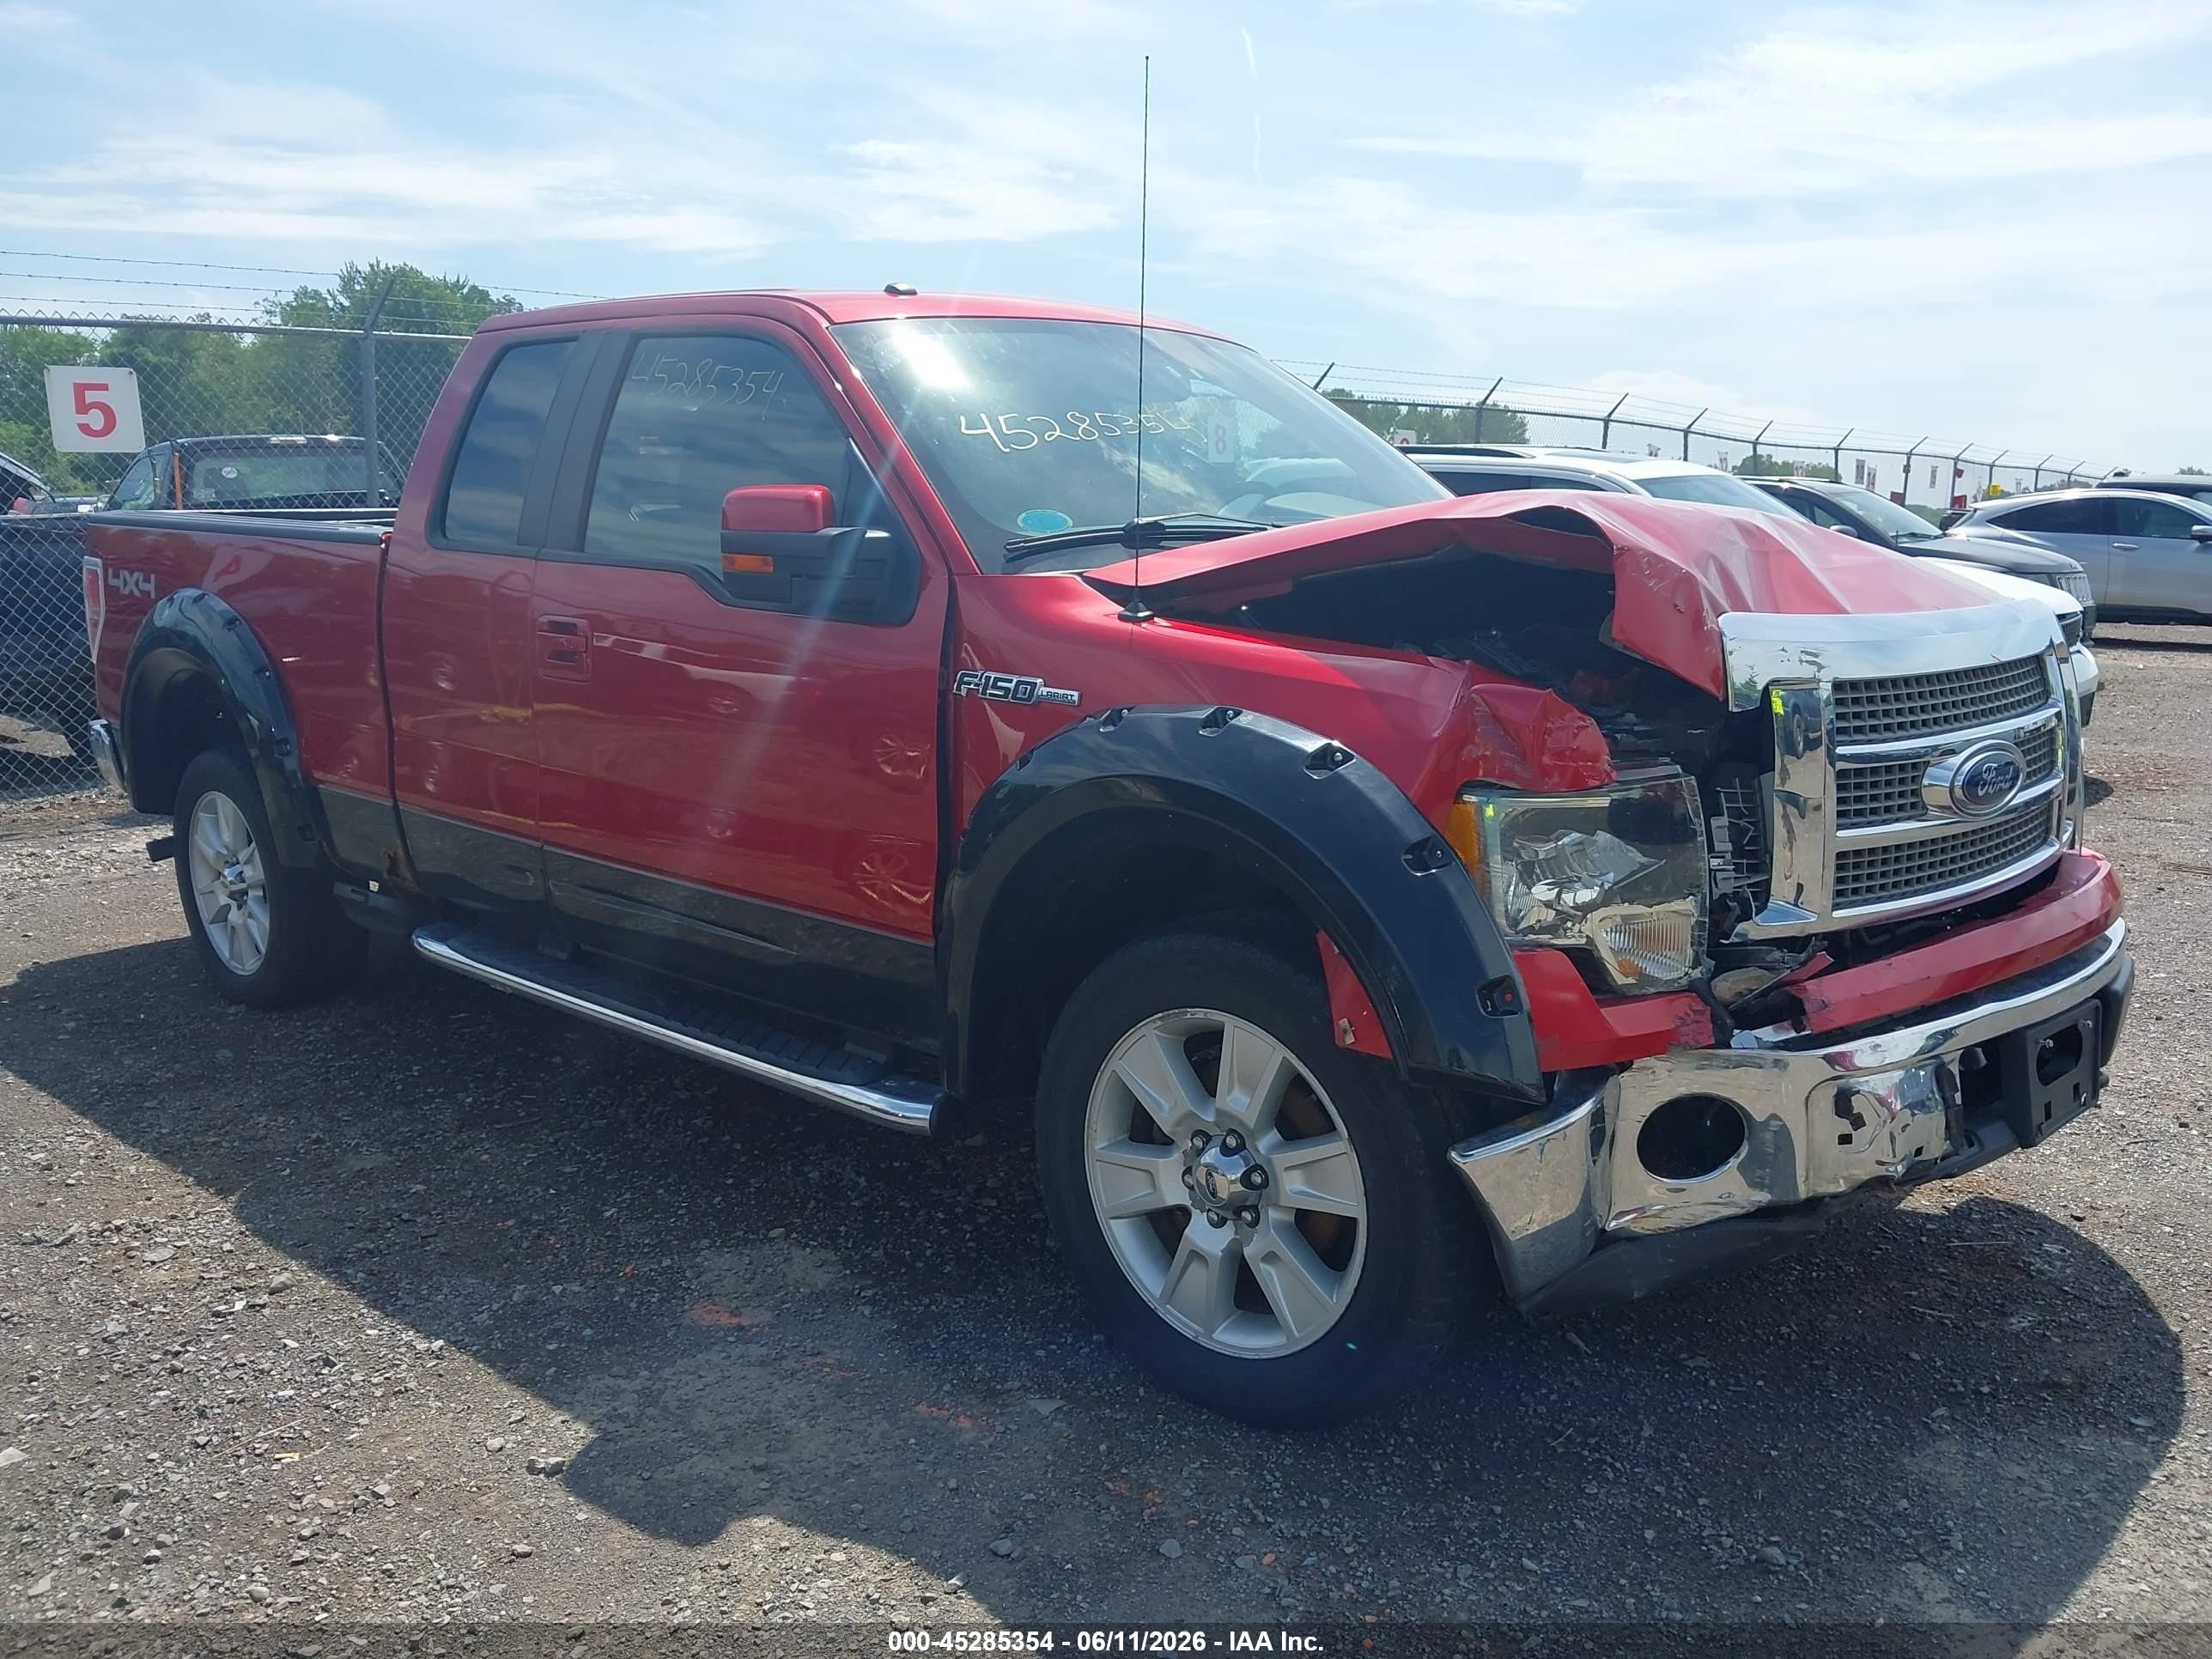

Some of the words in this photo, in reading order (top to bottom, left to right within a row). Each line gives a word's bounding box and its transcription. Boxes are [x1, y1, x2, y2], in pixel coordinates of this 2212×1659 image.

[632, 353, 783, 421] 45285354
[72, 381, 117, 438] 5
[959, 411, 1207, 453] 45285354
[953, 670, 1041, 705] F-150
[1040, 689, 1076, 704] LARIAT
[1977, 763, 2014, 797] Ford
